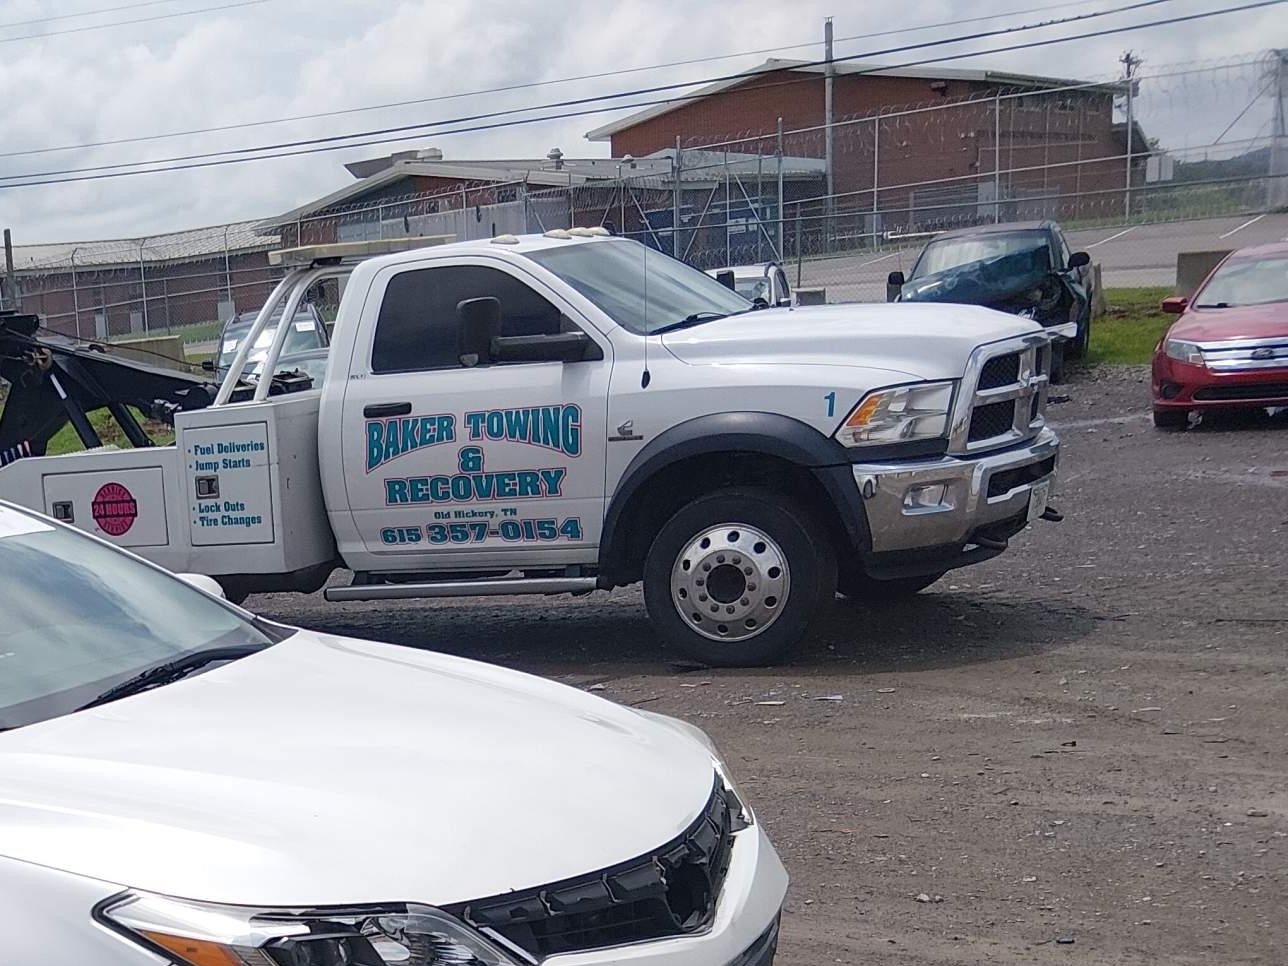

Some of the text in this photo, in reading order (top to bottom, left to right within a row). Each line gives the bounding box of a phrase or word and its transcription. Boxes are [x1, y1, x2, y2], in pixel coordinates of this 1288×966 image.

[824, 391, 835, 417] 1
[366, 404, 582, 472] BAKER TOWING
[194, 441, 265, 455] Fuel Deliveries
[195, 458, 250, 472] Jump Starts
[458, 446, 484, 472] &
[384, 468, 566, 505] RECOVERY
[94, 502, 135, 515] 24 HOURS
[198, 501, 245, 513] Lock Outs
[434, 508, 517, 519] Old Hickory, TN
[199, 514, 262, 527] Tire Changes
[381, 517, 583, 544] 615 357-0154
